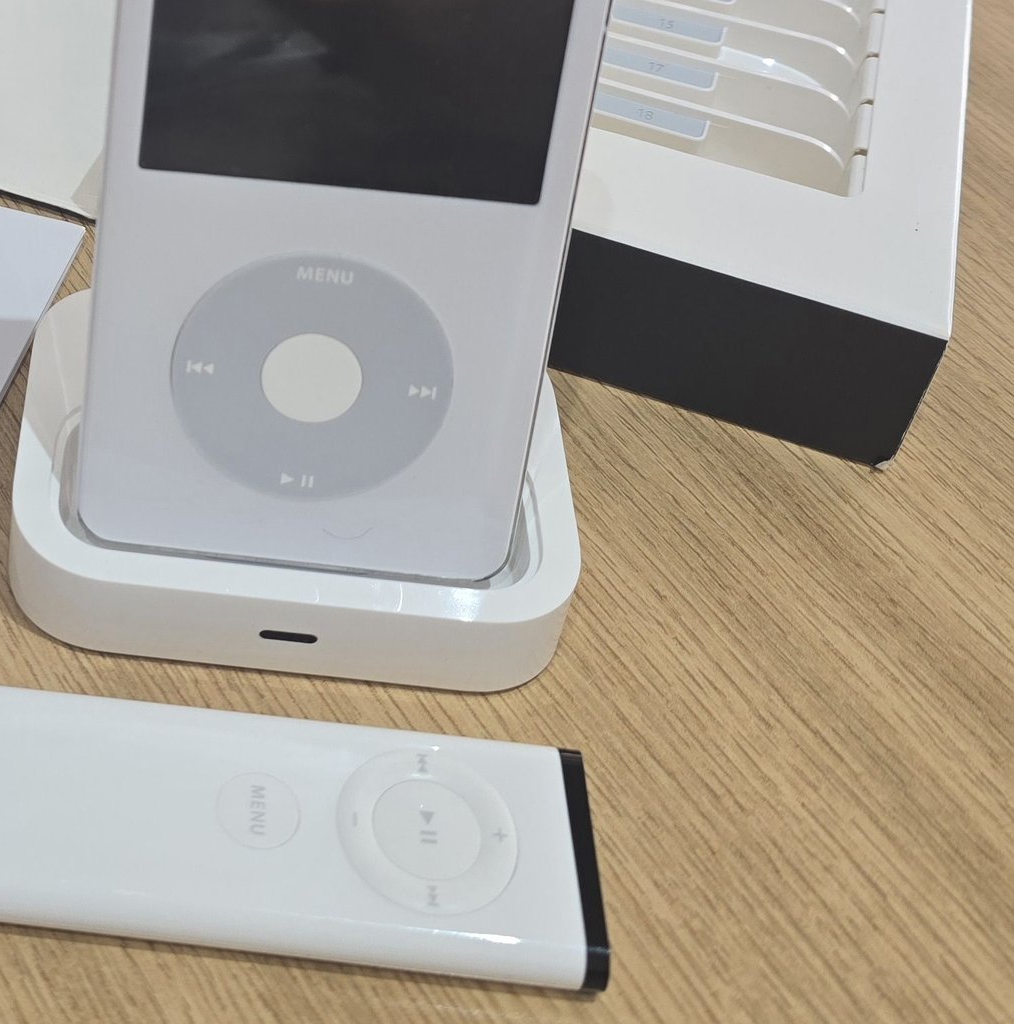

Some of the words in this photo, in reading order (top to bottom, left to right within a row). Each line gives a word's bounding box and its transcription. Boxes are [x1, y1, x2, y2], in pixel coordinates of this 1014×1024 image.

[649, 62, 665, 72] 17
[296, 265, 354, 285] MENU
[250, 784, 266, 836] MENU
